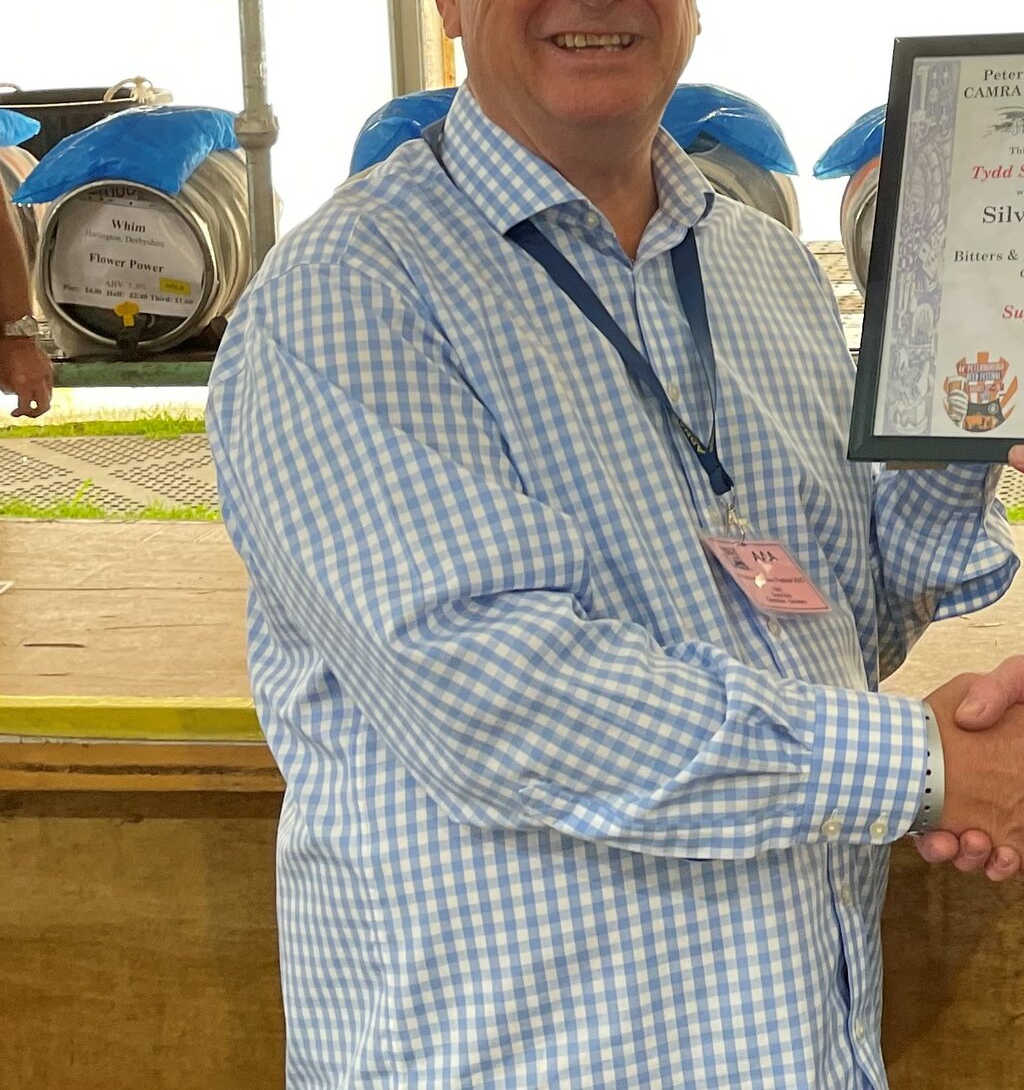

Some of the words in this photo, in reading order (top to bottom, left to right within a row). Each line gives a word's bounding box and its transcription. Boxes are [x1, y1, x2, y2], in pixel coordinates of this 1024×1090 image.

[963, 85, 1022, 99] CAMRA
[971, 164, 1013, 182] Tydd
[112, 219, 146, 234] Whim
[89, 252, 126, 268] Flower
[130, 259, 164, 273] Power
[953, 250, 1003, 262] Bitters
[1007, 250, 1020, 261] &
